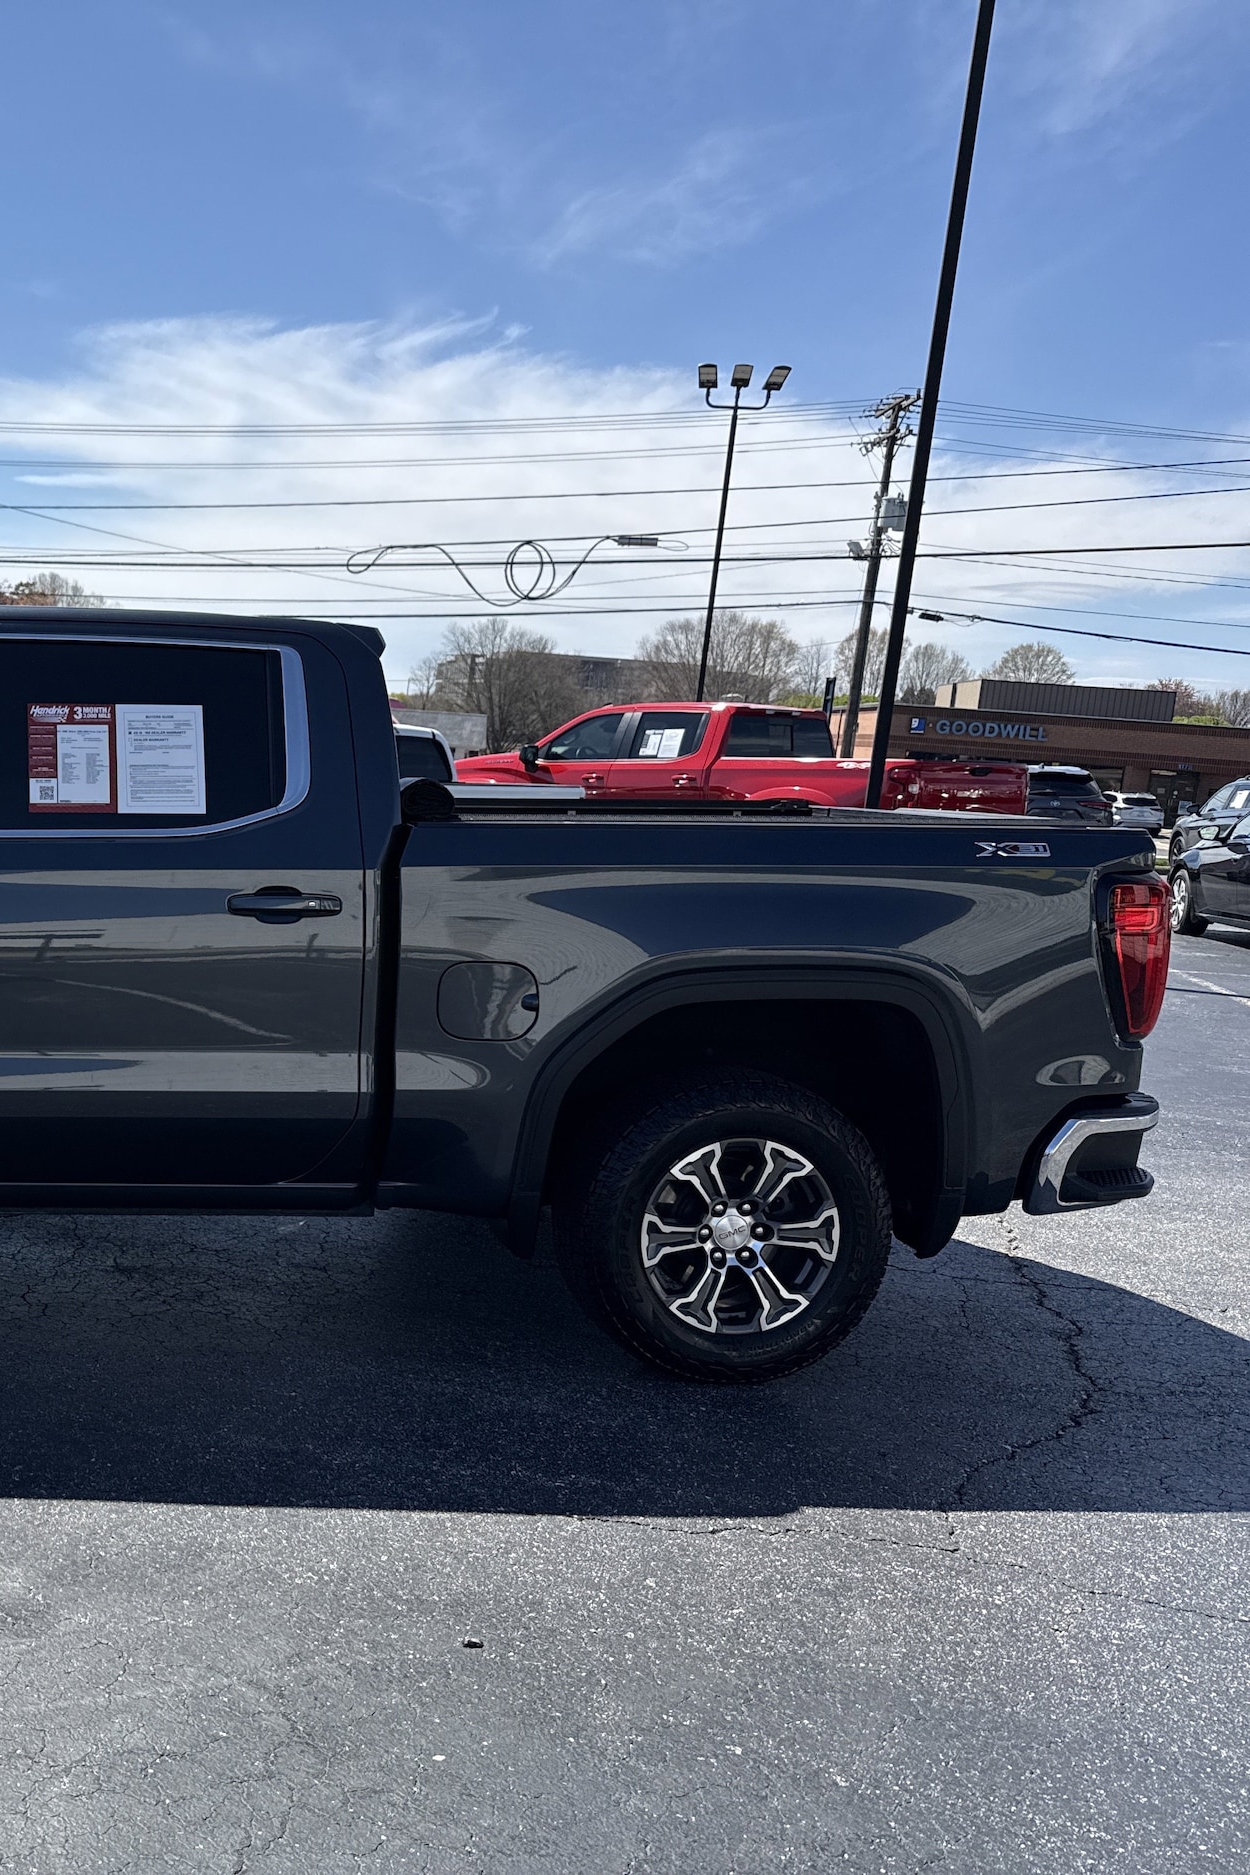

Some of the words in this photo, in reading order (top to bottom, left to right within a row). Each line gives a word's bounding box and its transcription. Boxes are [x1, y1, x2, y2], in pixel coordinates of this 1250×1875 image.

[73, 706, 83, 719] 3
[935, 719, 1048, 742] GOODWILL
[718, 1225, 747, 1240] GMC
